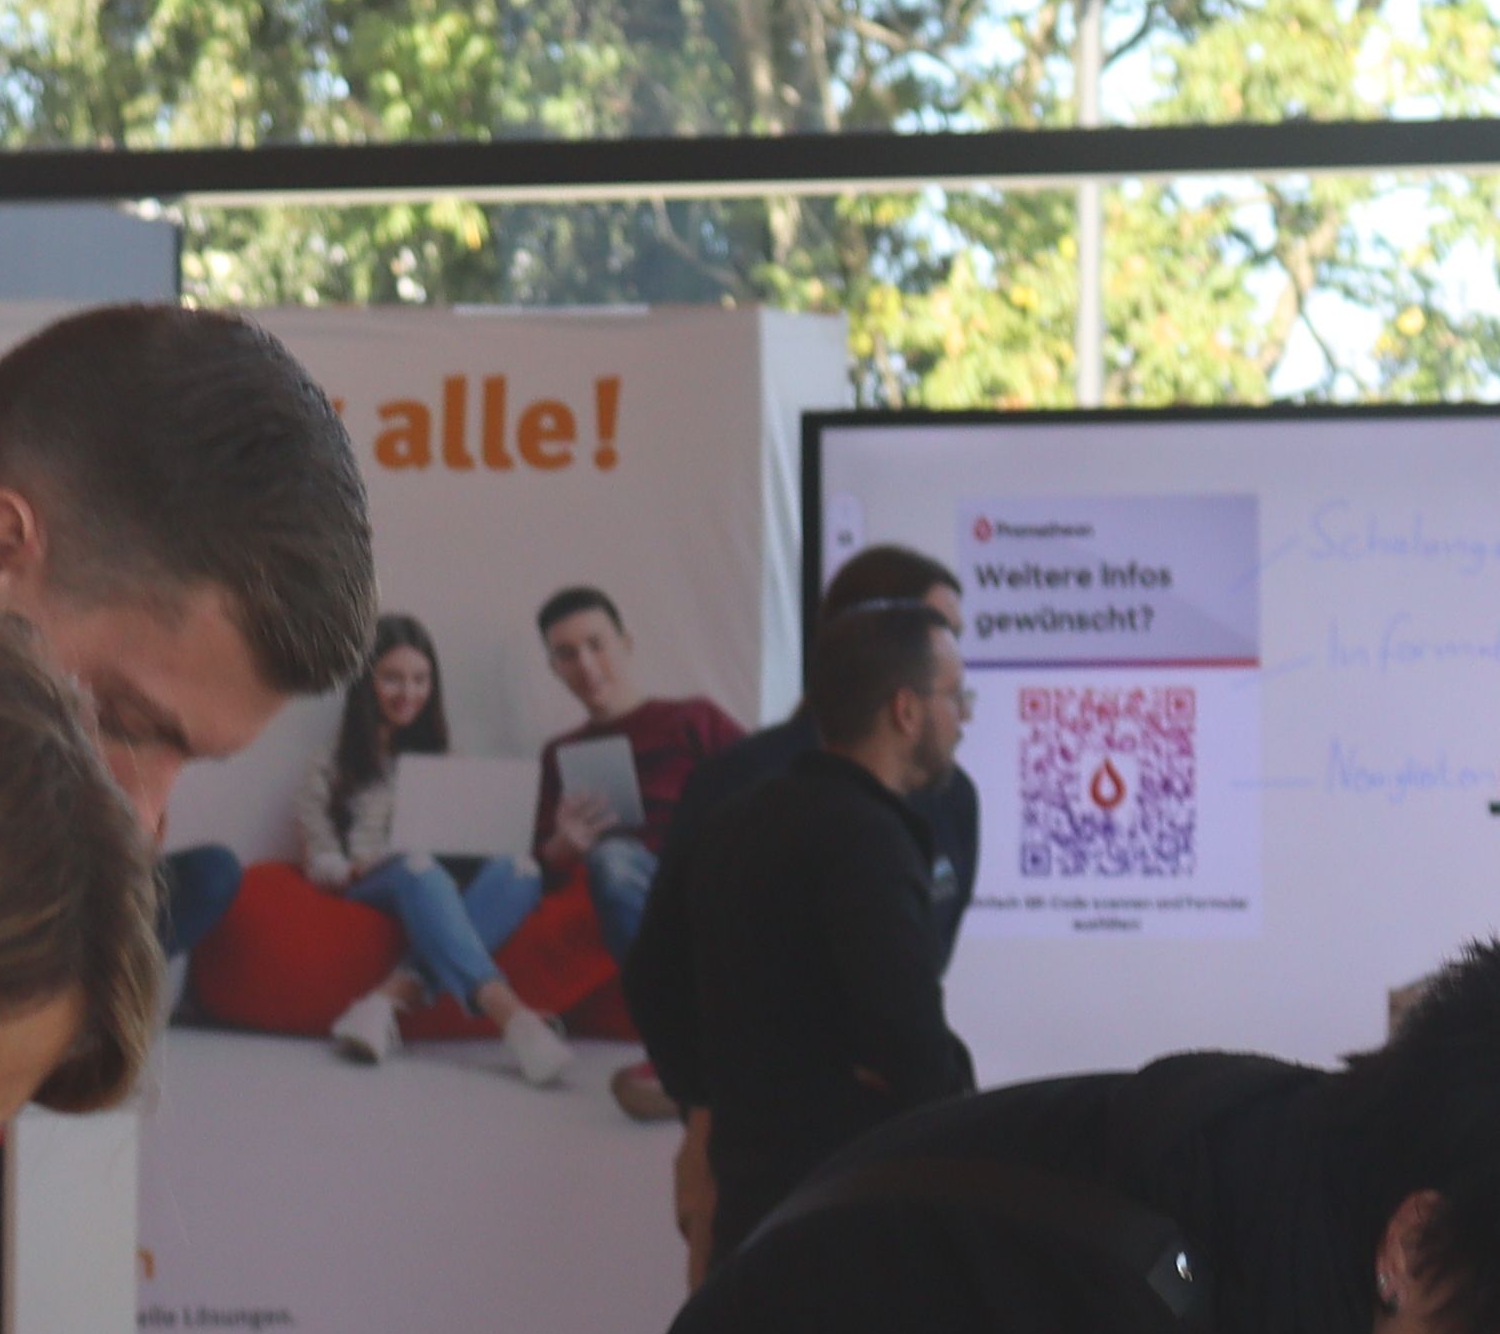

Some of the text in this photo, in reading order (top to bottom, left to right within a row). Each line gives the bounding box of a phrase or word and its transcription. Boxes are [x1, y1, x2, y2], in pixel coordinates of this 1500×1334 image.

[372, 373, 622, 471] alle!
[975, 560, 1173, 589] Weitere Infos
[975, 606, 1155, 640] gewünscht?
